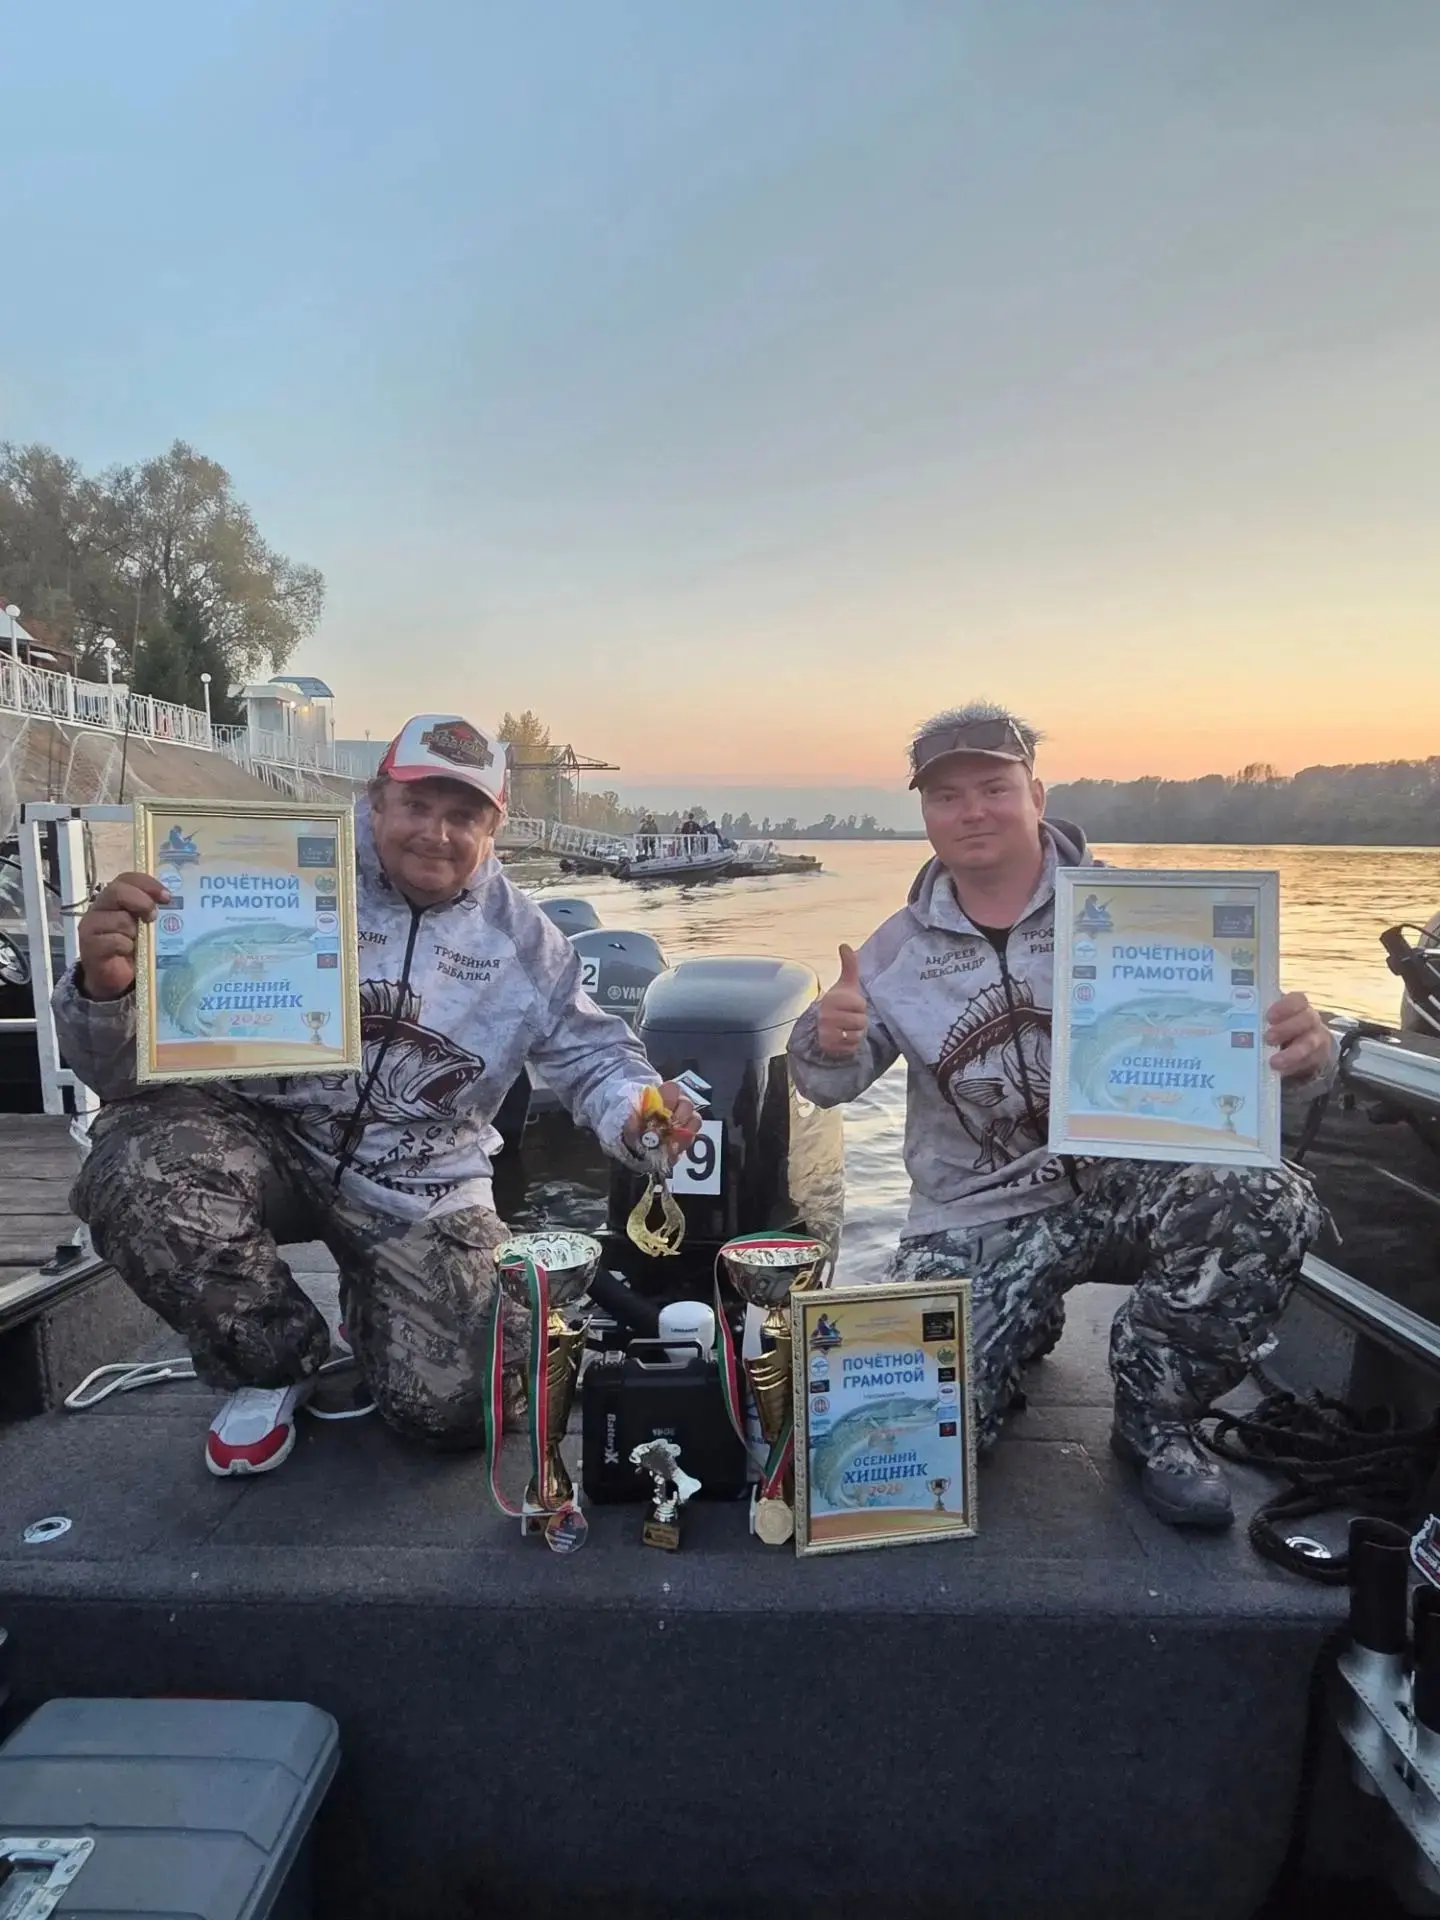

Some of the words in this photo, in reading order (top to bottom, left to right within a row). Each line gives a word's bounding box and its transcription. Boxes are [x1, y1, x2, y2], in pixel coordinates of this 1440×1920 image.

[199, 873, 300, 891] ПОЧЁТНОЙ
[200, 893, 300, 909] ГРАМОТОЙ
[433, 945, 501, 969] ТРОФЕЙНАЯ
[925, 947, 976, 966] АНДРЕЕВ
[1112, 945, 1215, 963] ПОЧЁТНОЙ
[436, 961, 491, 982] РЫБАЛКА
[581, 963, 597, 986] 2
[919, 956, 986, 980] АЛЕКСАНДР
[1112, 964, 1214, 983] ГРАМОТОЙ
[213, 978, 291, 994] ОСЕННИЙ
[199, 994, 304, 1012] ХИЩНИК
[1121, 1055, 1202, 1071] ОСЕННИЙ
[1109, 1070, 1216, 1090] ХИЩНИК
[842, 1350, 925, 1372] ПОЧЁТНОЙ
[843, 1369, 925, 1390] ГРАМОТОЙ
[853, 1450, 917, 1468] ОСЕННИЙ
[844, 1463, 929, 1485] ХИЩНИК
